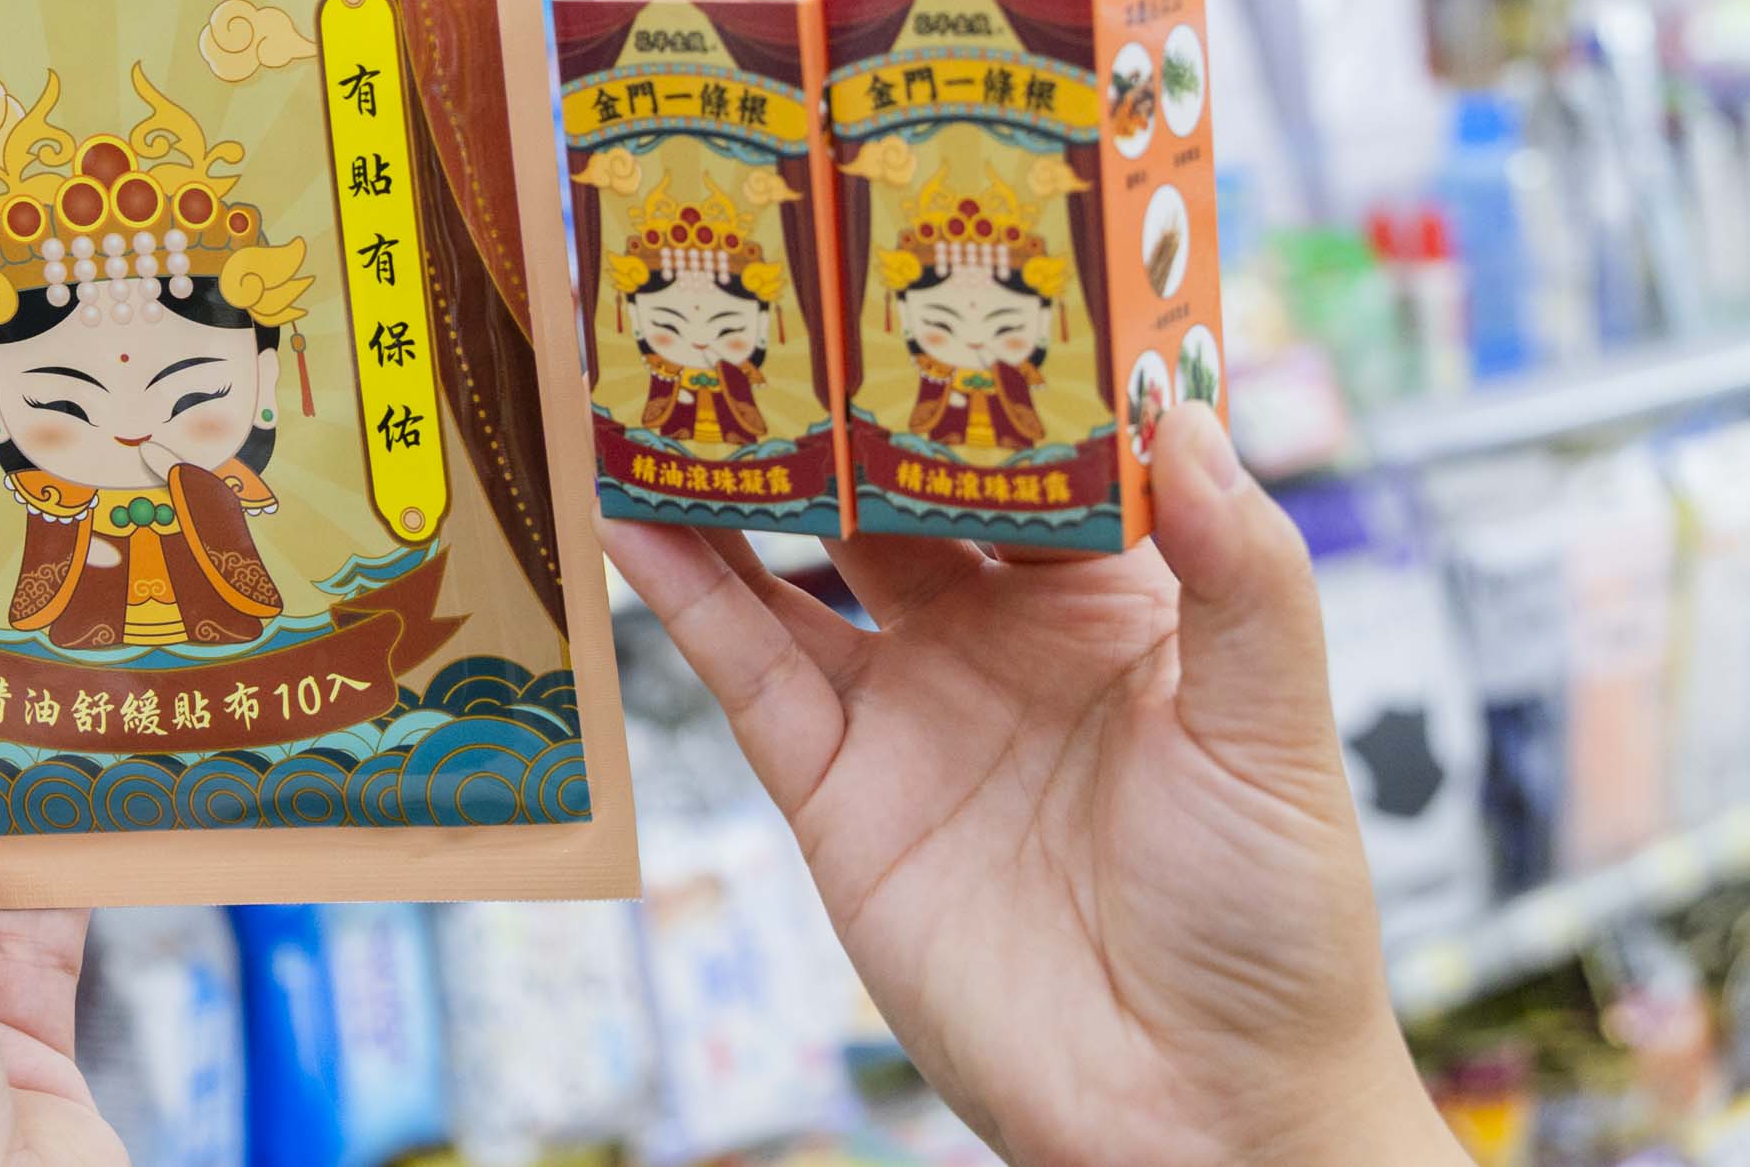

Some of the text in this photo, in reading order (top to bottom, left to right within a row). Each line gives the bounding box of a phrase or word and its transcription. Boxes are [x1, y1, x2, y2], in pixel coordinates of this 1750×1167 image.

[592, 82, 771, 128] 金門一條根
[865, 66, 1058, 114] 金門一條根
[338, 63, 422, 452] 有貼有保佑
